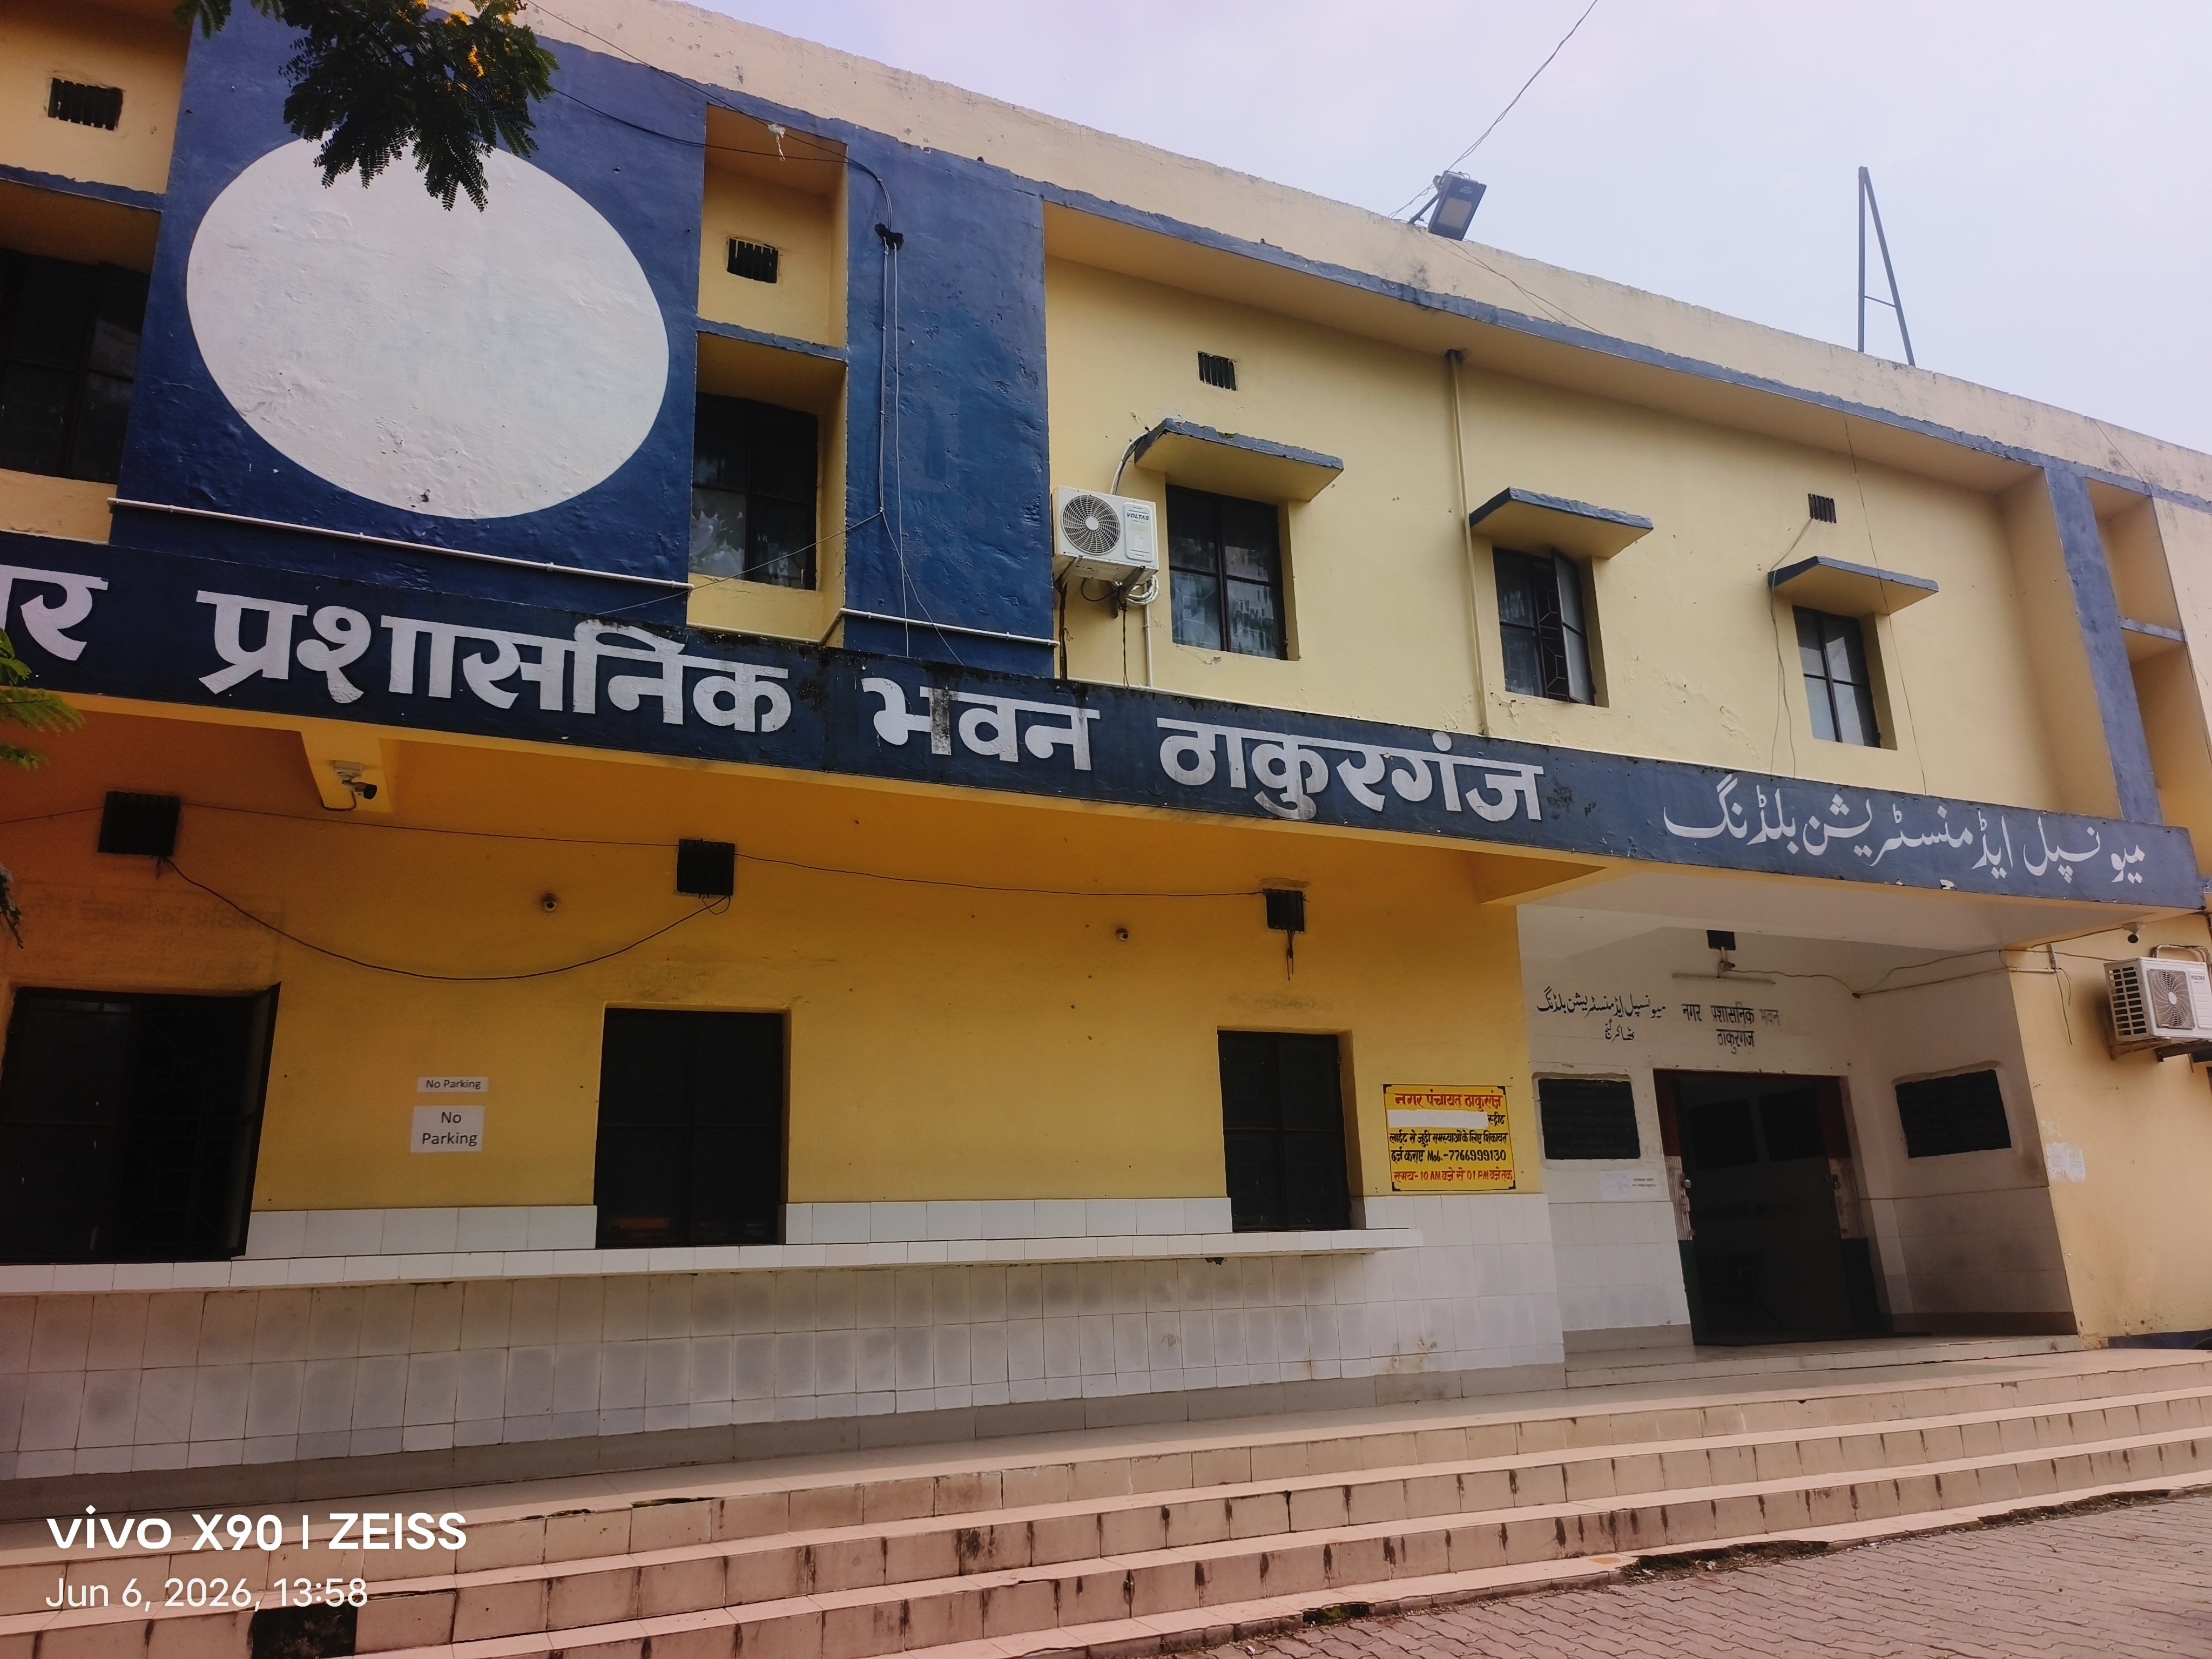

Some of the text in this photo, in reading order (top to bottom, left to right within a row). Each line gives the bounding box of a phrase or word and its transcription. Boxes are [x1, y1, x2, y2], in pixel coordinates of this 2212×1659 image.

[1127, 512, 1149, 521] VOLTAS
[196, 589, 791, 732] प्रशासनिक
[862, 677, 1100, 771] भवन
[1157, 717, 1543, 821] ठाकुरगंज
[1682, 1003, 1702, 1022] नगर
[426, 1080, 481, 1090] No Parking
[1394, 1089, 1503, 1112] नगर पंचायत ठाकुरगंज
[441, 1111, 462, 1124] No
[422, 1132, 478, 1147] Parking
[1409, 1129, 1417, 1144] से
[1468, 1129, 1483, 1144] लिए
[1483, 1129, 1508, 1145] शिकायत
[1420, 1171, 1429, 1181] 10
[1467, 1170, 1475, 1180] 01
